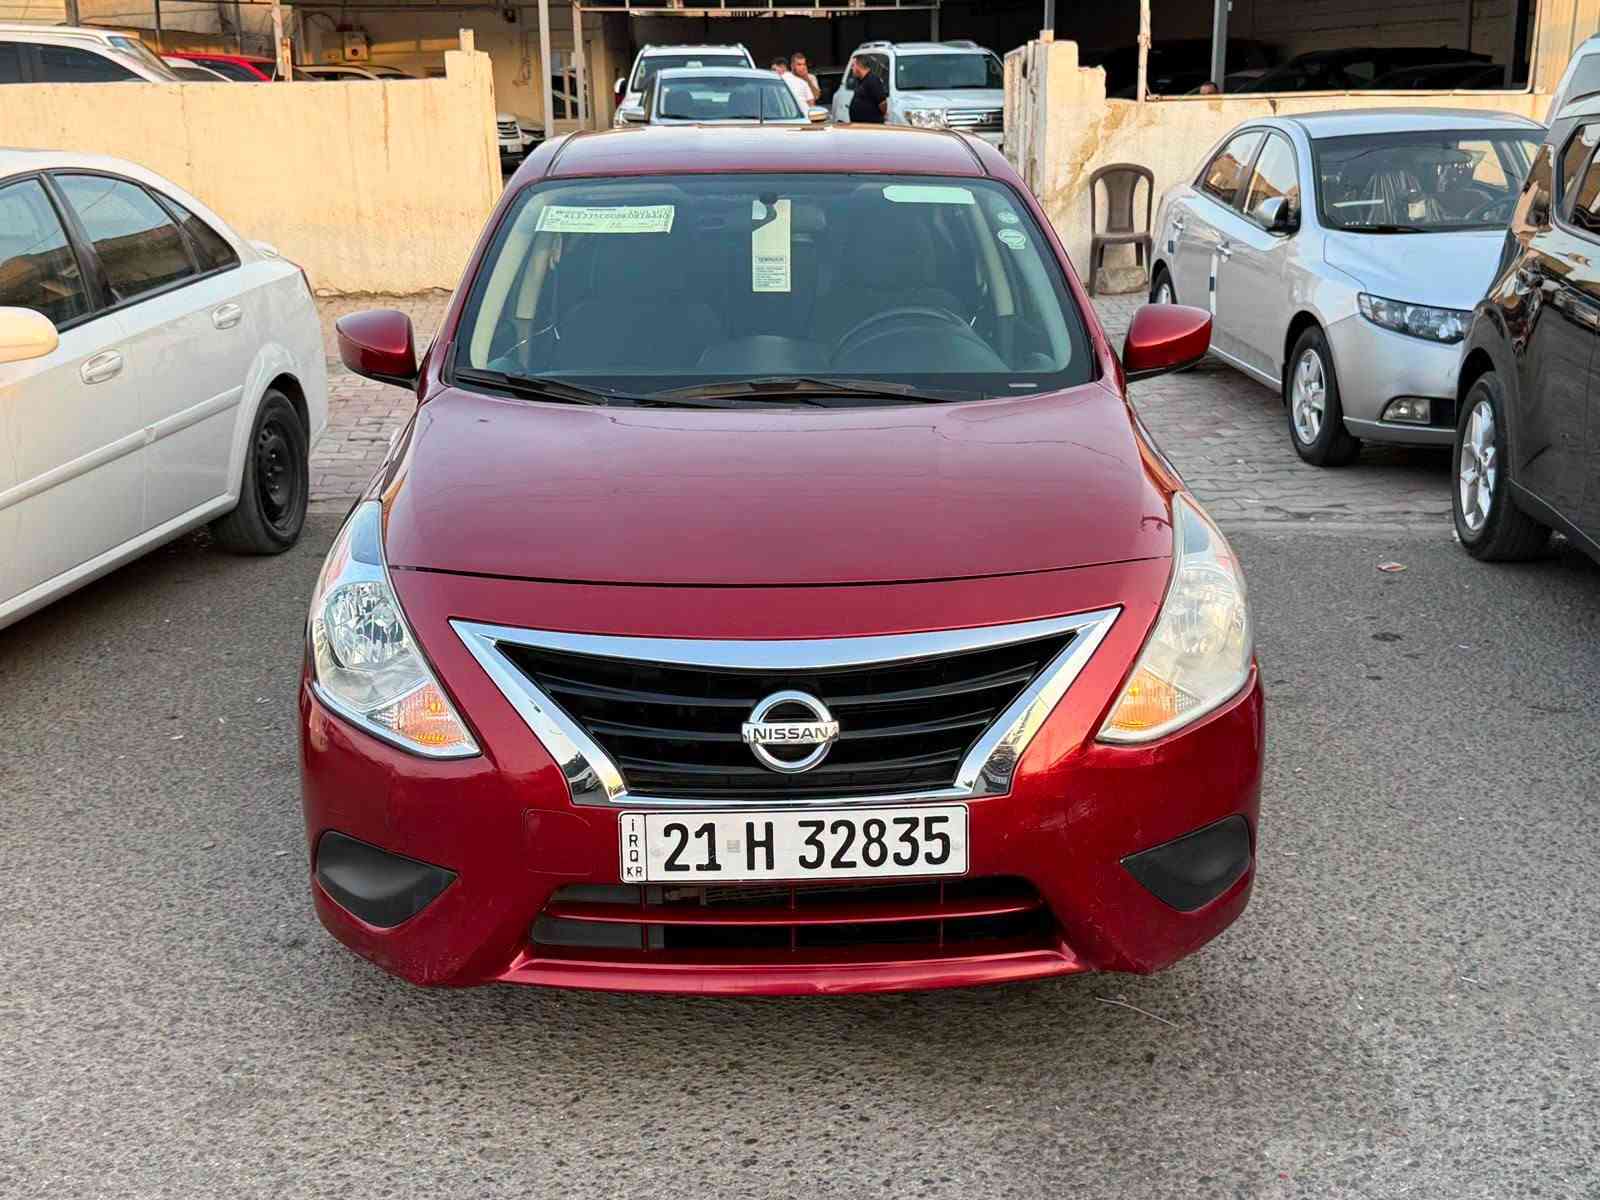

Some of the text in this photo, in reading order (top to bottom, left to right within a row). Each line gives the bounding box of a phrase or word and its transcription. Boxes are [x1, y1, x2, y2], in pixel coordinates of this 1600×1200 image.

[753, 727, 829, 740] NISSAN
[664, 816, 950, 872] 21 H 32835
[626, 866, 643, 877] KR
